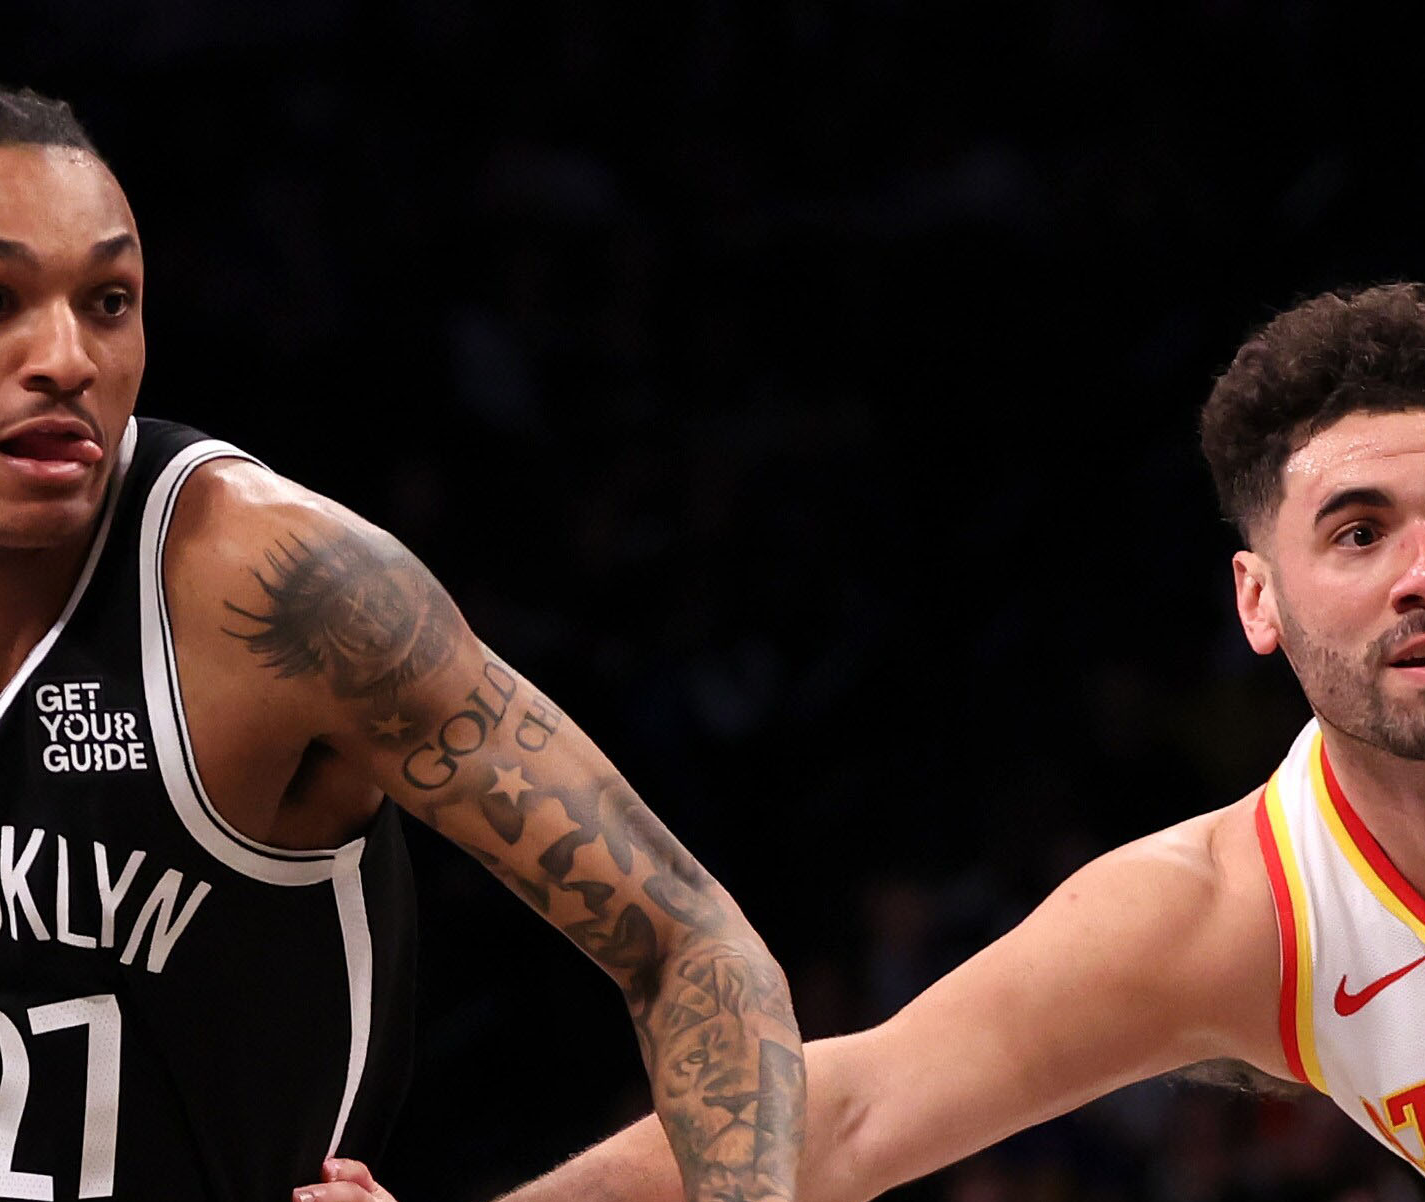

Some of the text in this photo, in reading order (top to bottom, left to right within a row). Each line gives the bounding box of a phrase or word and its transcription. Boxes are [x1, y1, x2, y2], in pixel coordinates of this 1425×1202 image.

[35, 682, 100, 712] GET
[38, 711, 138, 742] YOUR
[42, 742, 148, 773] GUIDE
